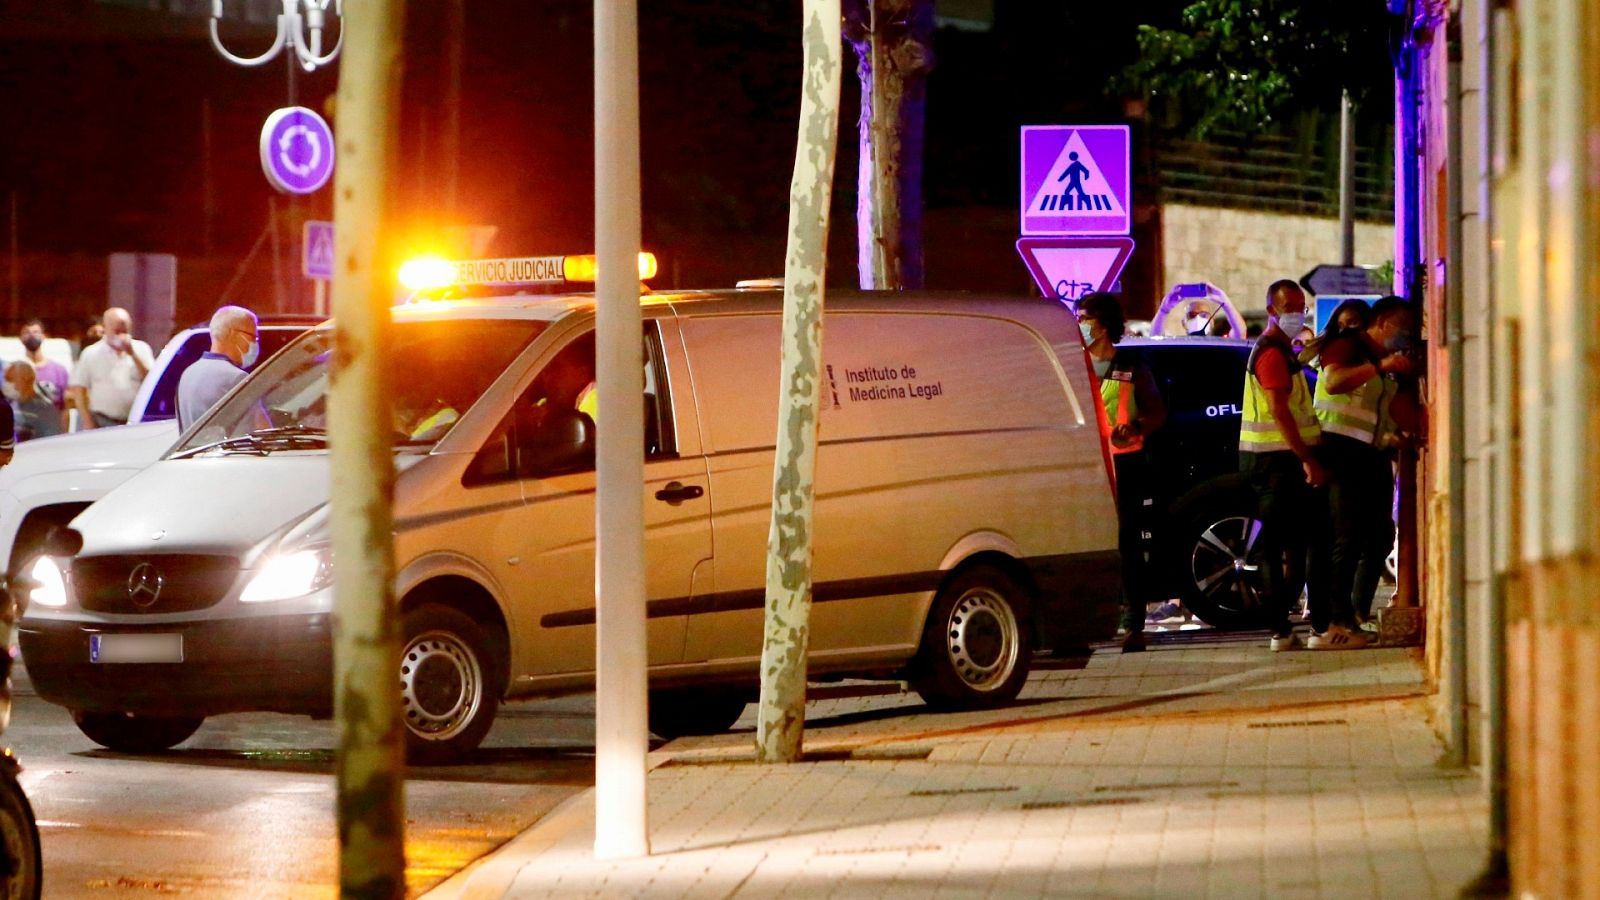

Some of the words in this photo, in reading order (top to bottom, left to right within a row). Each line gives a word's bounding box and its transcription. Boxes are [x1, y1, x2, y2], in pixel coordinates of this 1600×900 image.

[509, 258, 563, 281] JUDICIAL
[845, 366, 898, 383] Instituto
[901, 365, 917, 379] de
[849, 383, 906, 402] Medicina
[908, 381, 943, 400] Legal
